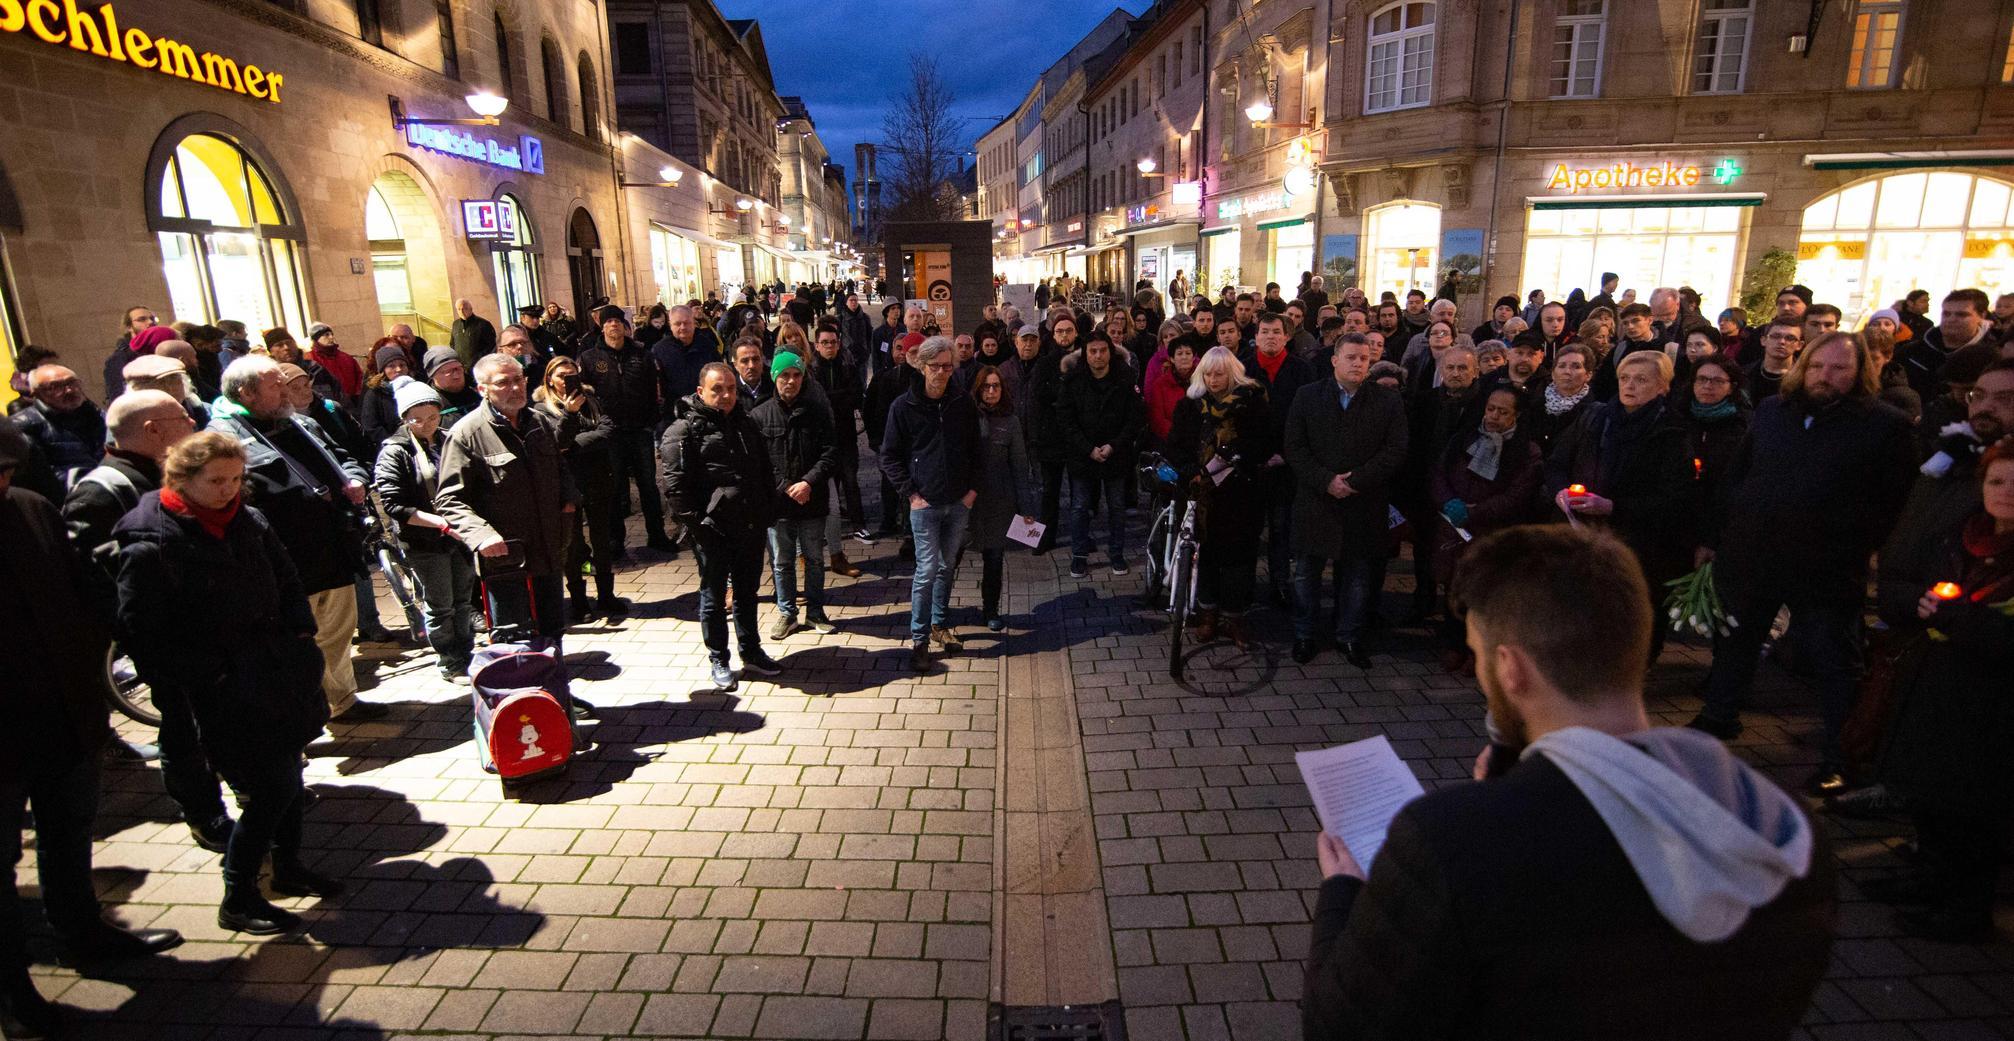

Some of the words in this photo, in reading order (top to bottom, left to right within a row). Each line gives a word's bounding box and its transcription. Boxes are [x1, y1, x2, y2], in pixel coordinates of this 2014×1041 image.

[409, 115, 487, 160] Deutsche
[486, 139, 523, 169] Bank
[1546, 160, 1702, 194] Apotheke
[1801, 244, 1861, 254] L'OCANE
